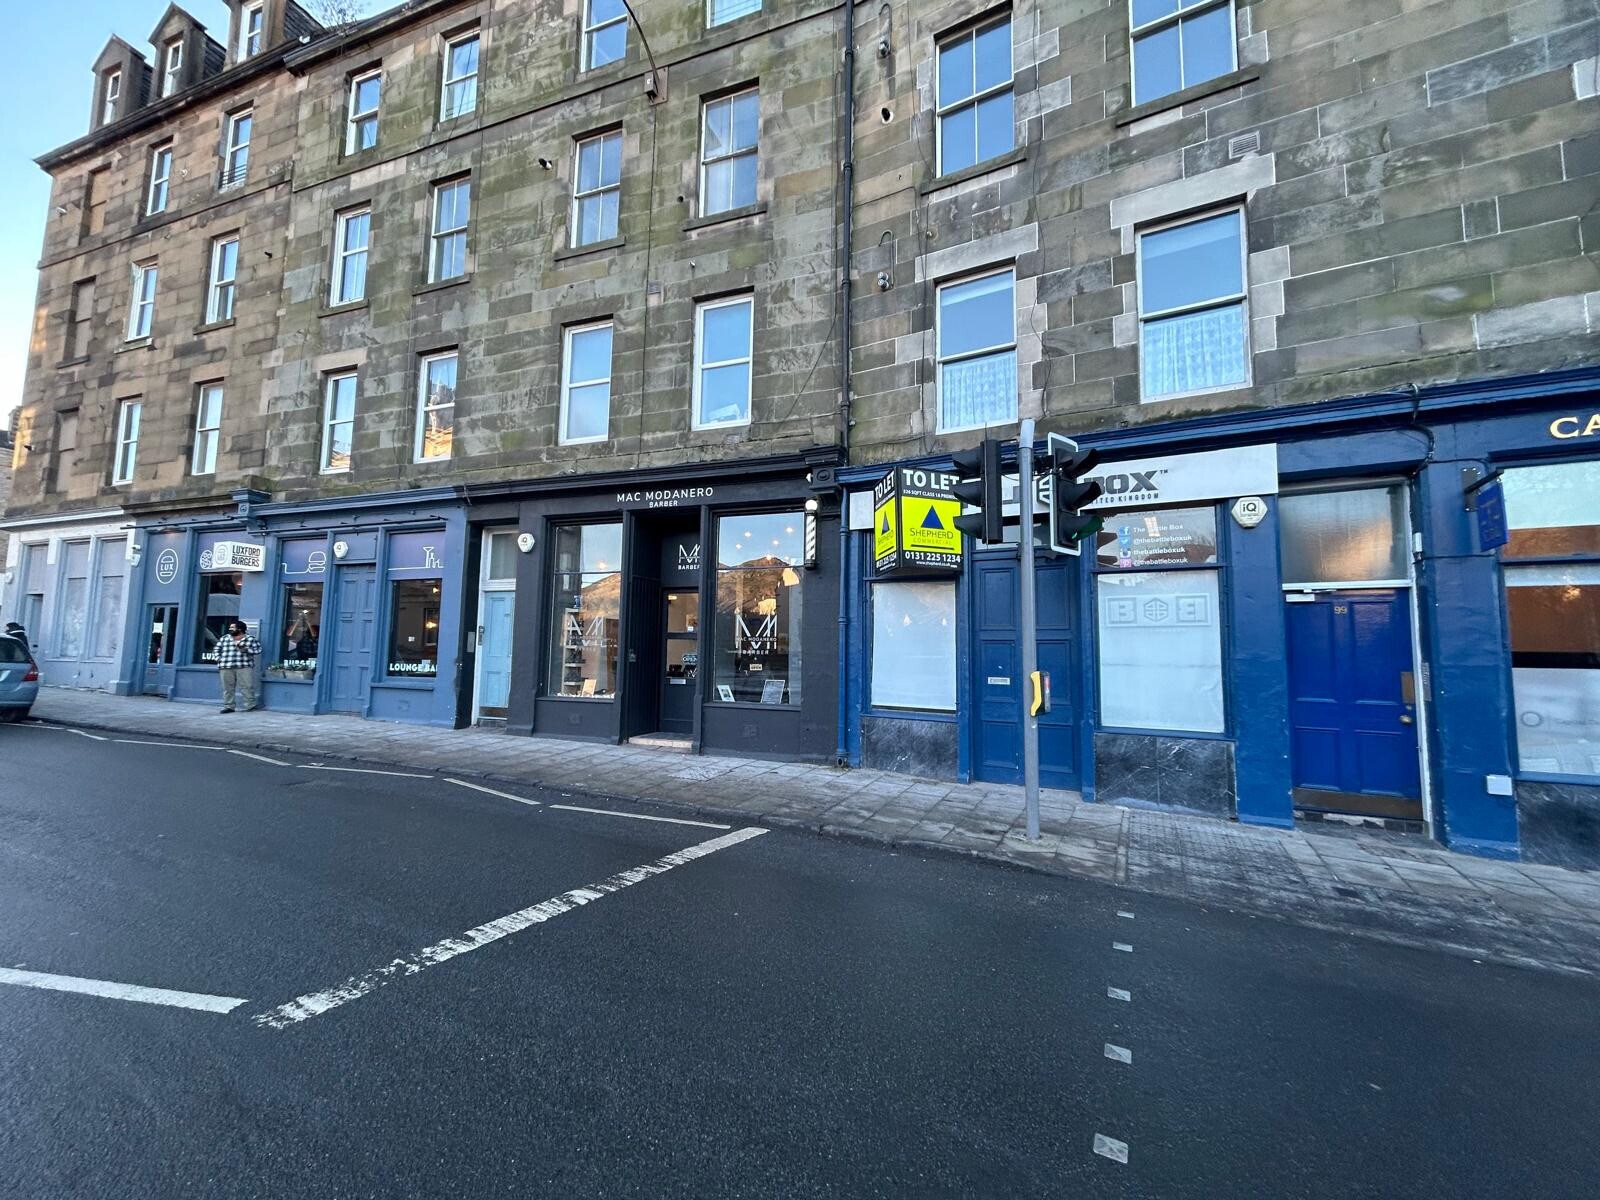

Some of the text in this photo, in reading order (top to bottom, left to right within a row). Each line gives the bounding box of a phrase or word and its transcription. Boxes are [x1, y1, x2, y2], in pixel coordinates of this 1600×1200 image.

[903, 469, 960, 490] TO LET
[875, 482, 883, 502] TO
[883, 471, 895, 495] LET
[617, 487, 714, 502] MAC MODANERO
[1119, 493, 1159, 502] KINGDOM
[649, 500, 678, 508] BARBER
[1242, 502, 1257, 512] iQ
[909, 528, 954, 539] SHEPHERD
[232, 545, 260, 557] LUXFORD
[231, 556, 260, 568] BURGERS
[905, 551, 924, 560] 0131
[926, 553, 941, 561] 225
[943, 554, 961, 563] 1234
[160, 563, 174, 571] LUX
[1334, 606, 1347, 614] 99
[389, 663, 423, 672] LOUNGE
